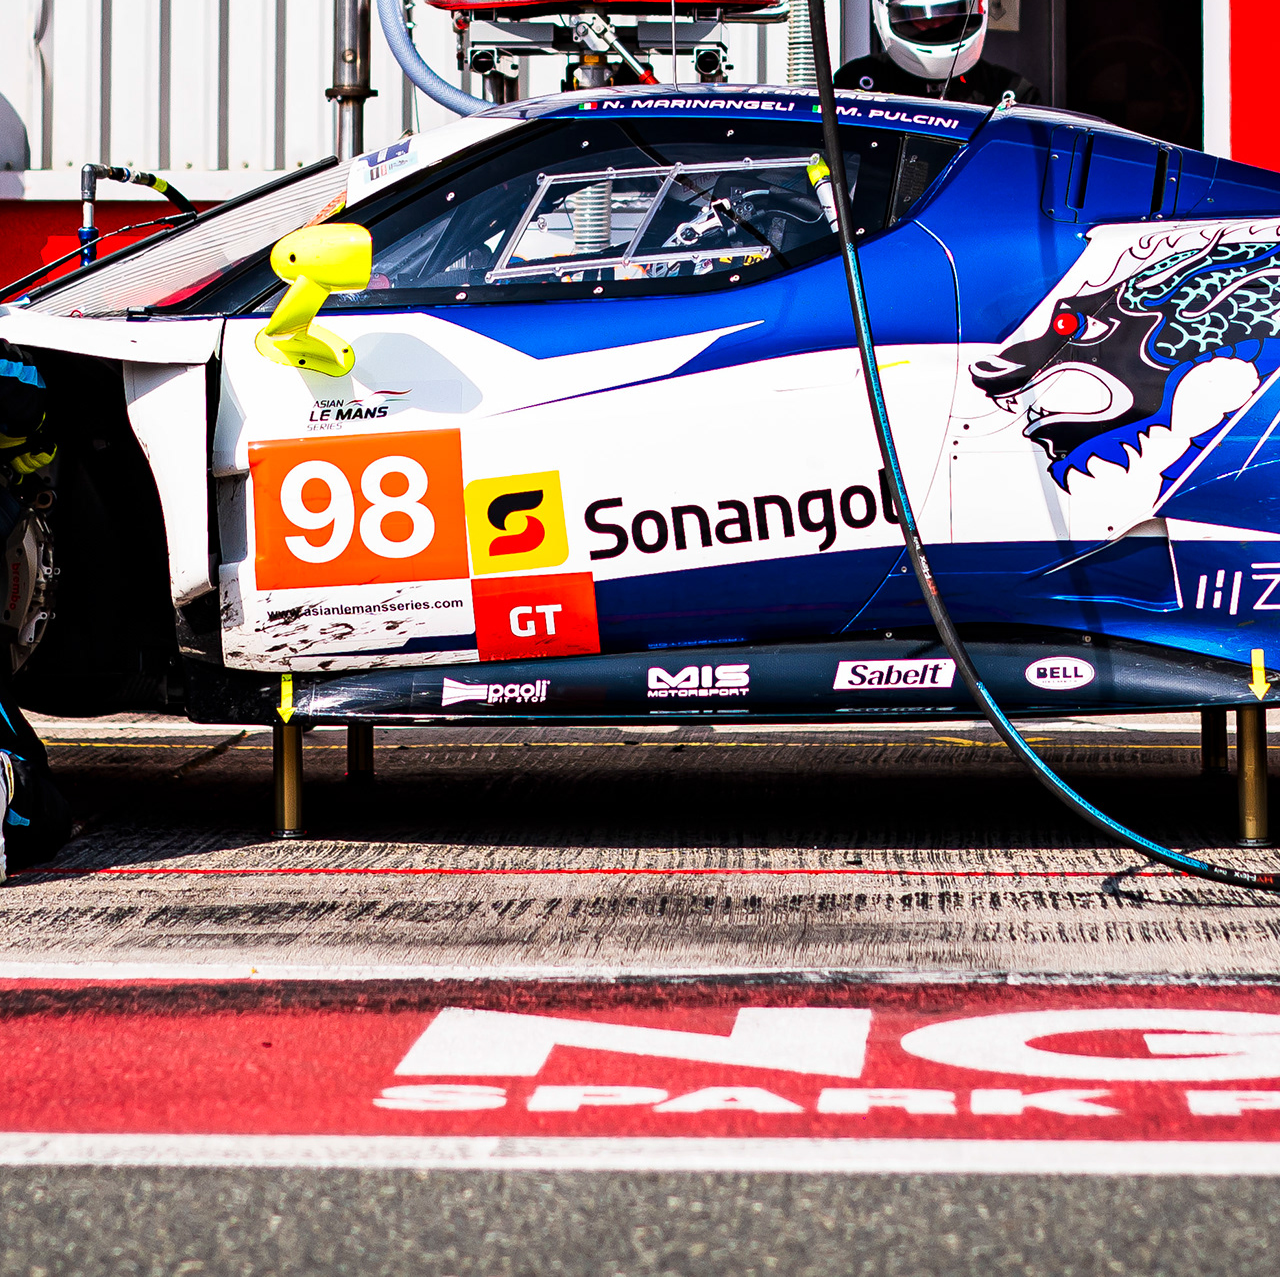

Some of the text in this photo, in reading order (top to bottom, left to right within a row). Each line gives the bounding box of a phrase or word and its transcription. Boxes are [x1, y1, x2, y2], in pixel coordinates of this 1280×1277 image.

[602, 99, 795, 112] N. MARINANGELI
[836, 106, 960, 130] M. PULCINI
[308, 406, 389, 422] LE MANS
[312, 399, 345, 408] ASIAN
[306, 422, 343, 431] SERIES
[280, 455, 435, 564] 98
[584, 467, 902, 561] Sonangol
[9, 562, 20, 610] brembo
[509, 604, 562, 637] GT
[647, 664, 750, 689] MIS
[848, 663, 942, 686] Sabelt
[1036, 666, 1084, 679] BELL
[488, 679, 547, 701] paoli
[647, 687, 750, 698] MOTORSPORT
[372, 1083, 1126, 1119] SPARK
